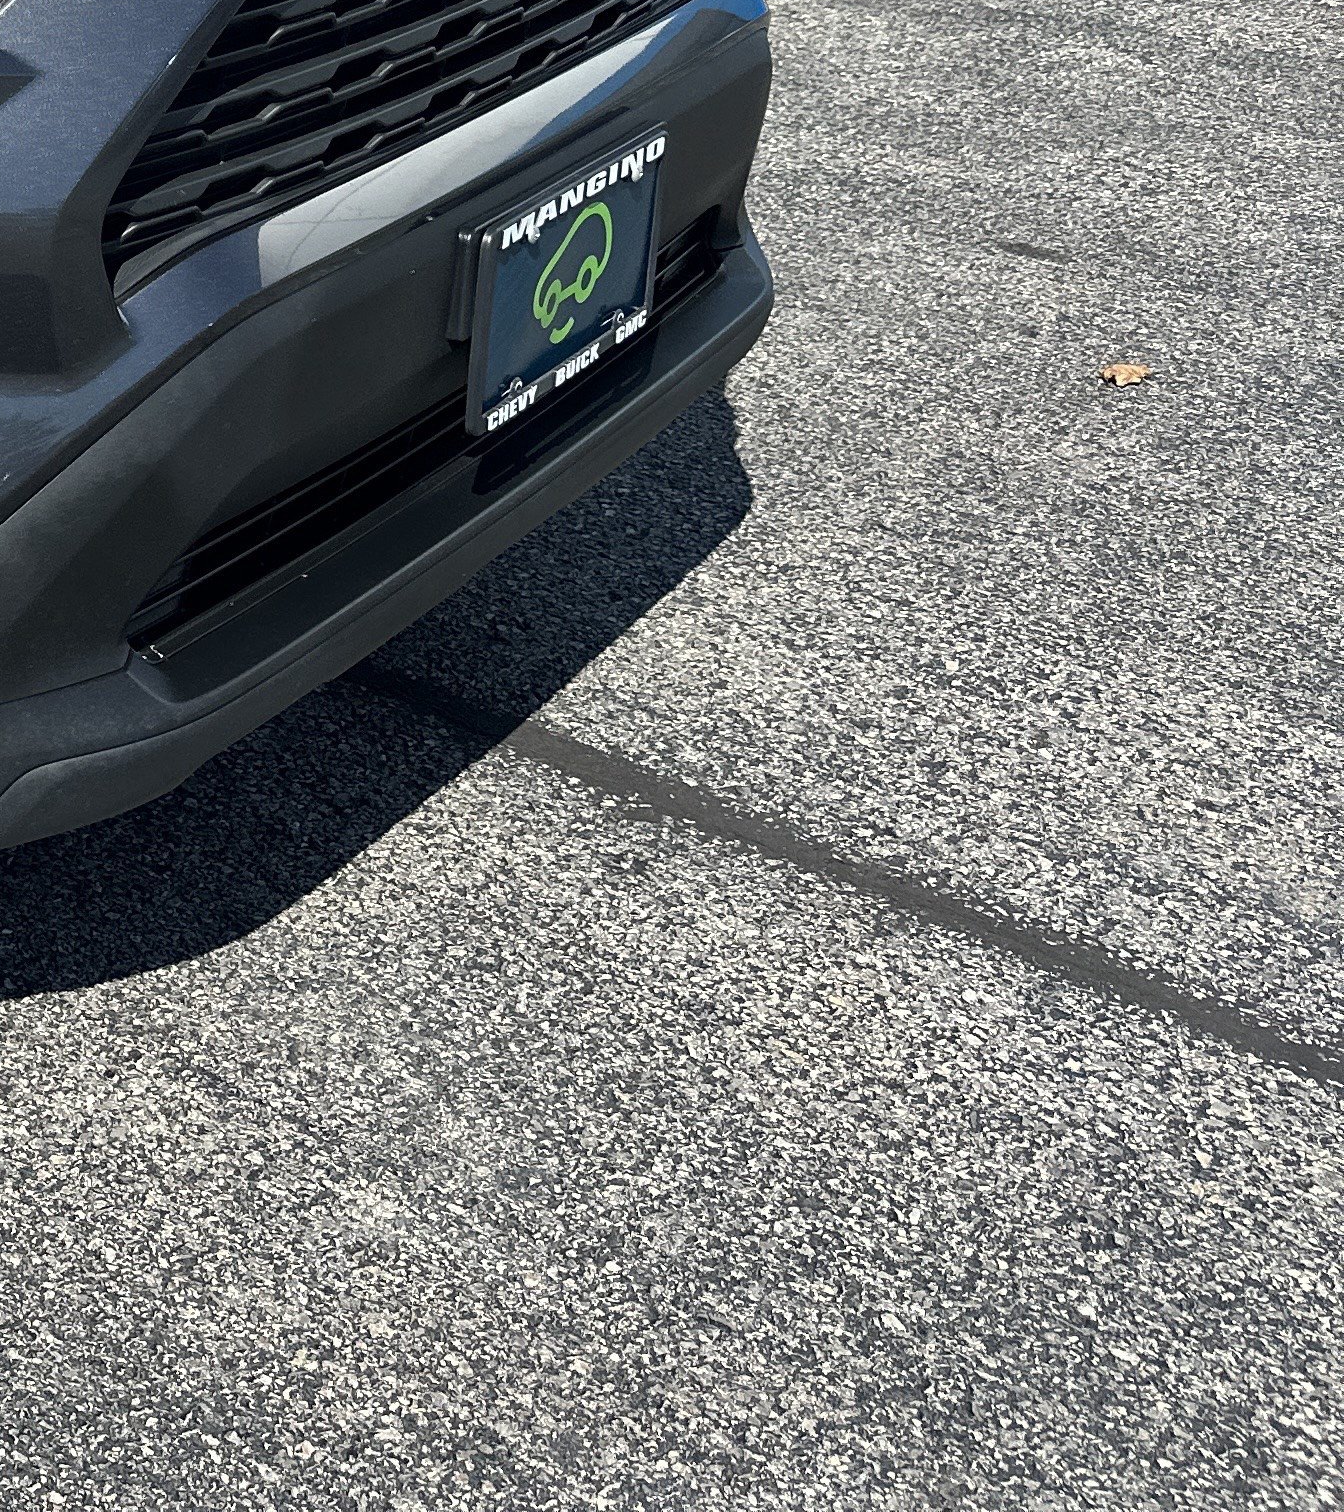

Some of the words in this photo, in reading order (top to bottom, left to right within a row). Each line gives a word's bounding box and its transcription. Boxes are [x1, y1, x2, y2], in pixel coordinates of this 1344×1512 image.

[501, 136, 666, 250] MANGINO
[486, 385, 538, 432] CHEVY
[554, 343, 600, 387] BUICK
[614, 309, 648, 345] GMC
